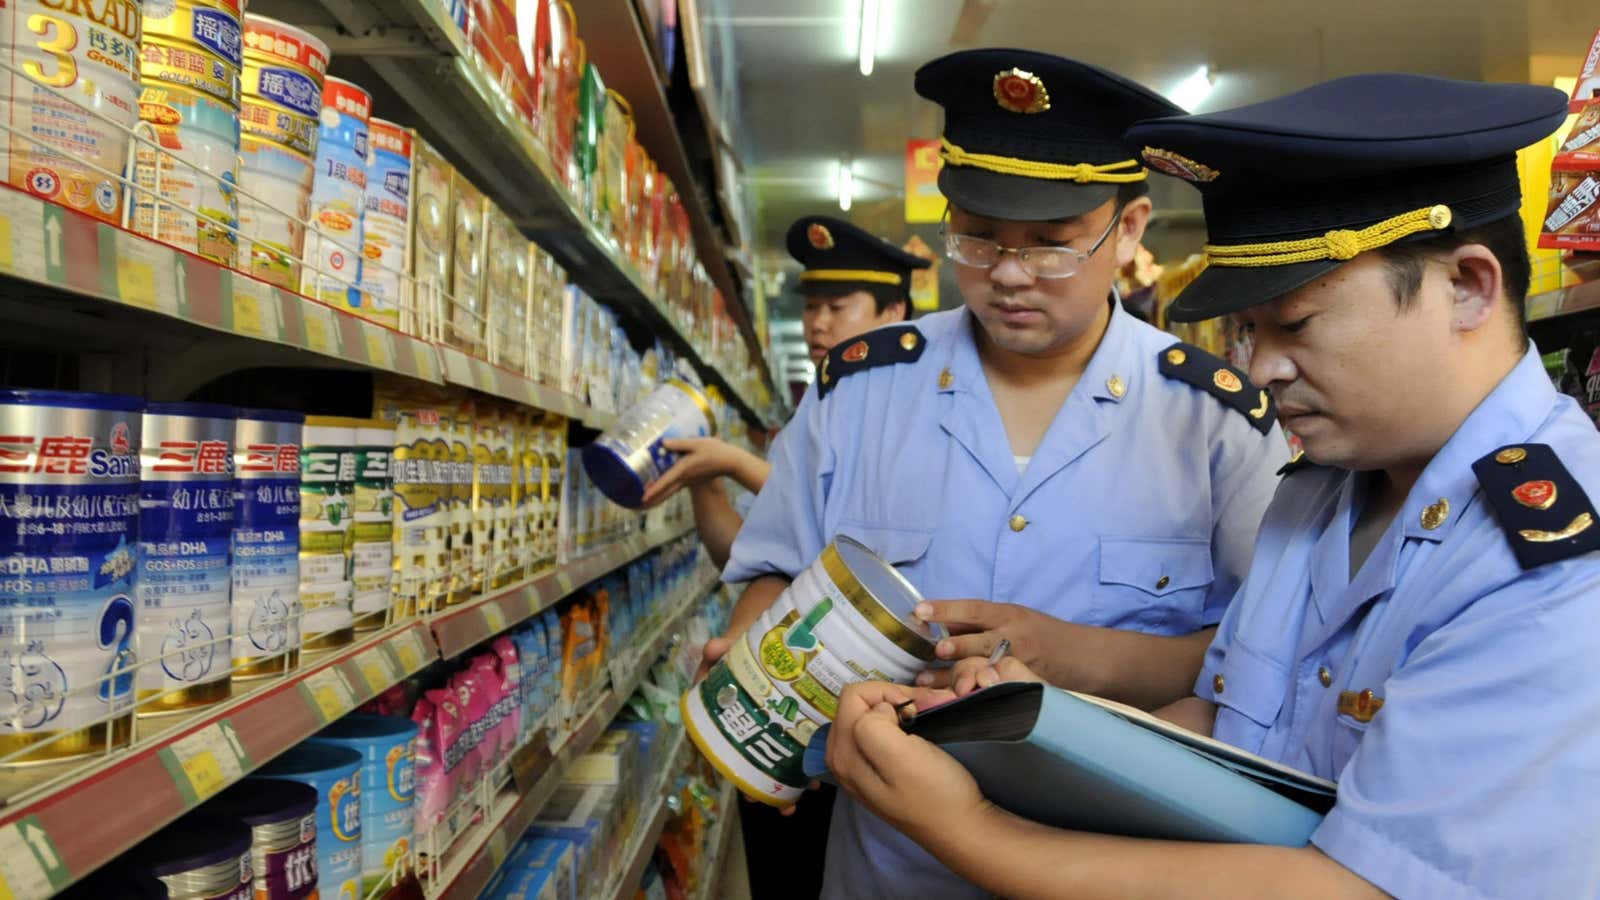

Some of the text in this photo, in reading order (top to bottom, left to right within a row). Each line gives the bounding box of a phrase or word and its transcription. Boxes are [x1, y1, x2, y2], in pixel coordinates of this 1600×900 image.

[22, 13, 79, 88] 3
[0, 435, 93, 475] 三鹿
[152, 440, 228, 474] 三鹿
[241, 444, 299, 472] 三鹿
[180, 541, 208, 556] DHA
[263, 530, 286, 543] DHA
[9, 557, 49, 574] DHA
[717, 701, 795, 770] 三鹿
